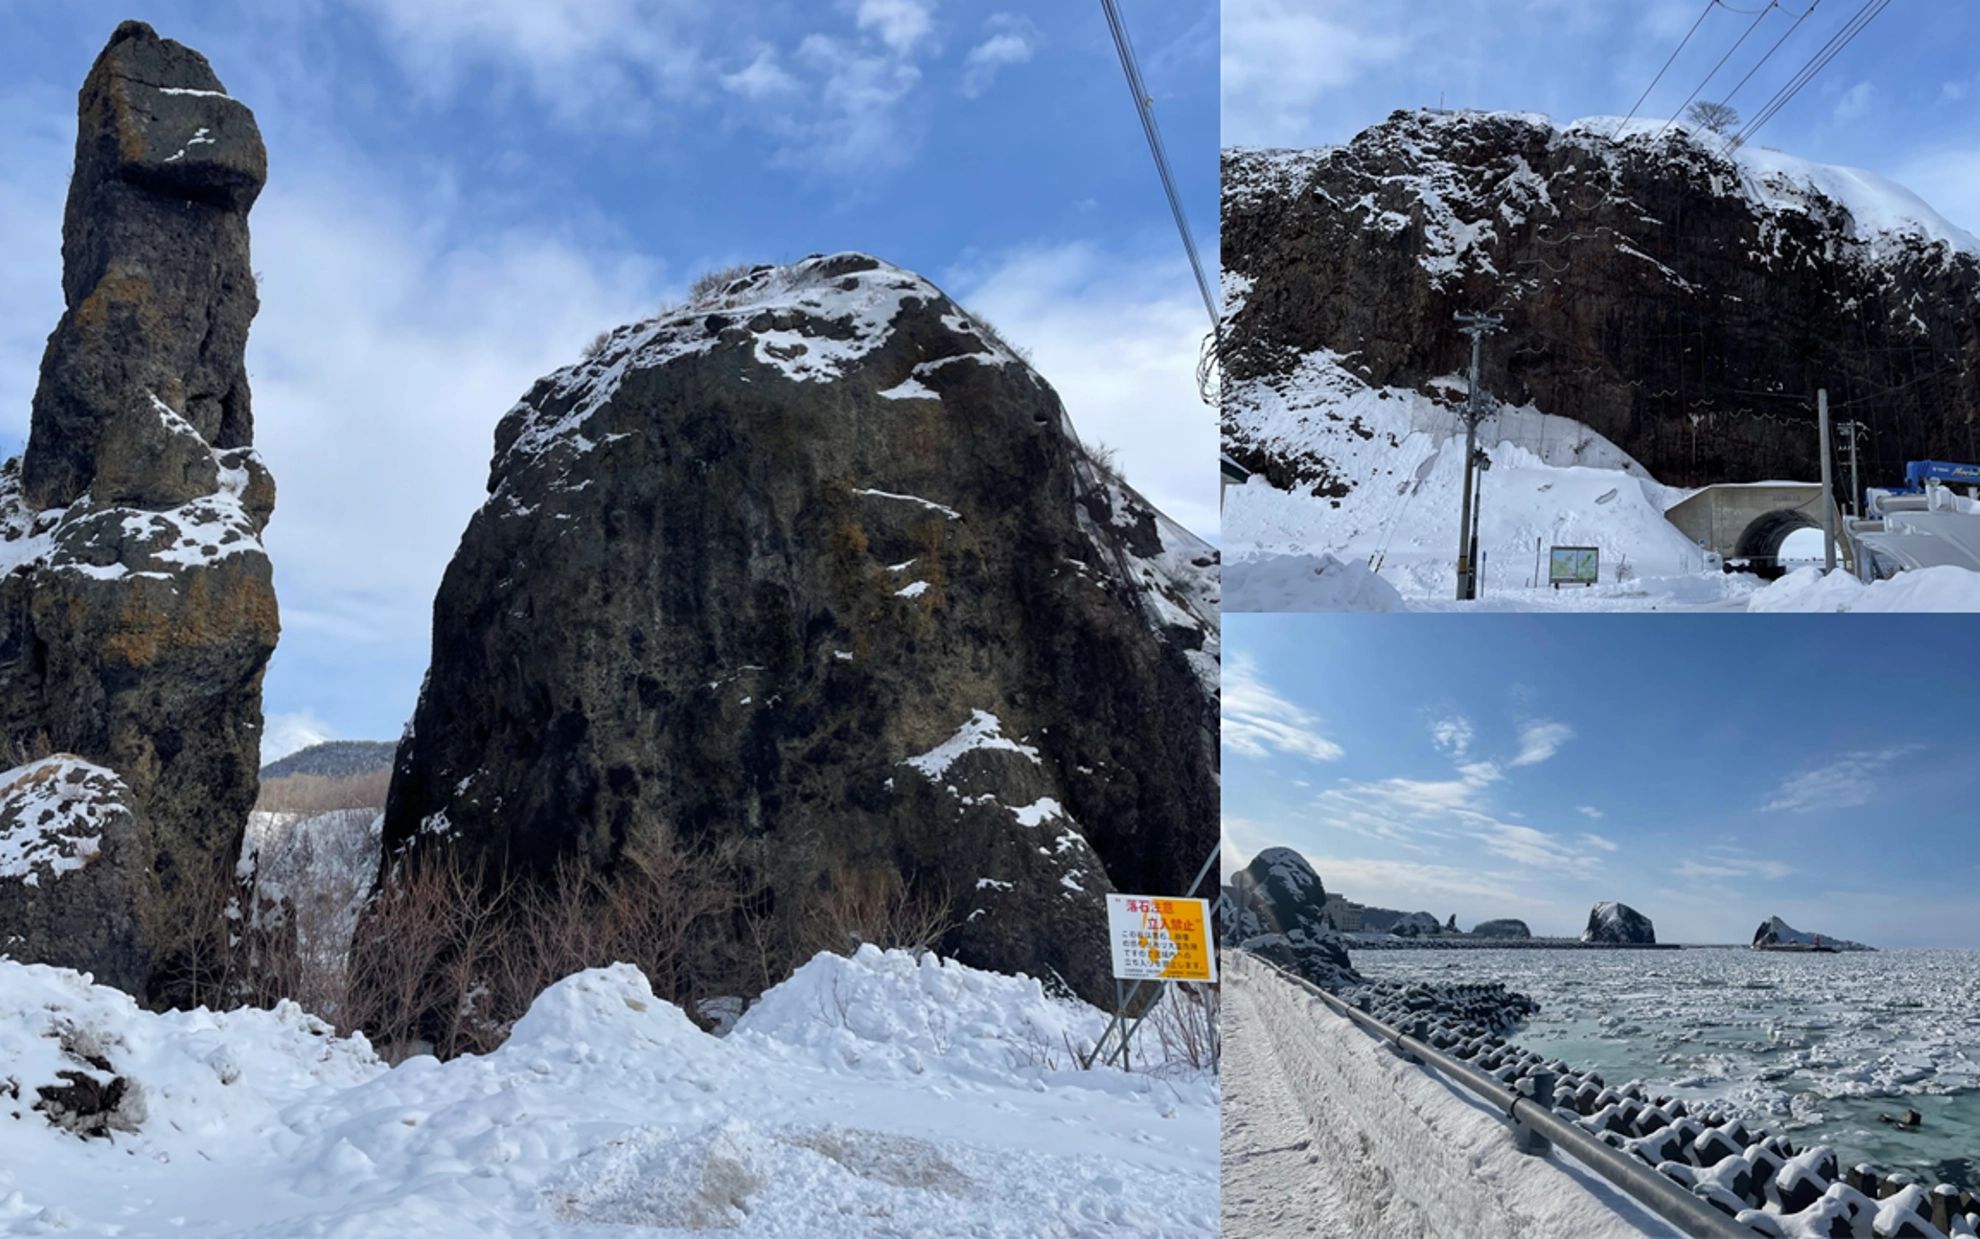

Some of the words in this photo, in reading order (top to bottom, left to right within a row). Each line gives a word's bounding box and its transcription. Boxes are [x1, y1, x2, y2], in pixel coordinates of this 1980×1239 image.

[1126, 899, 1174, 914] 落石注意
[1147, 918, 1195, 932] 立入禁止
